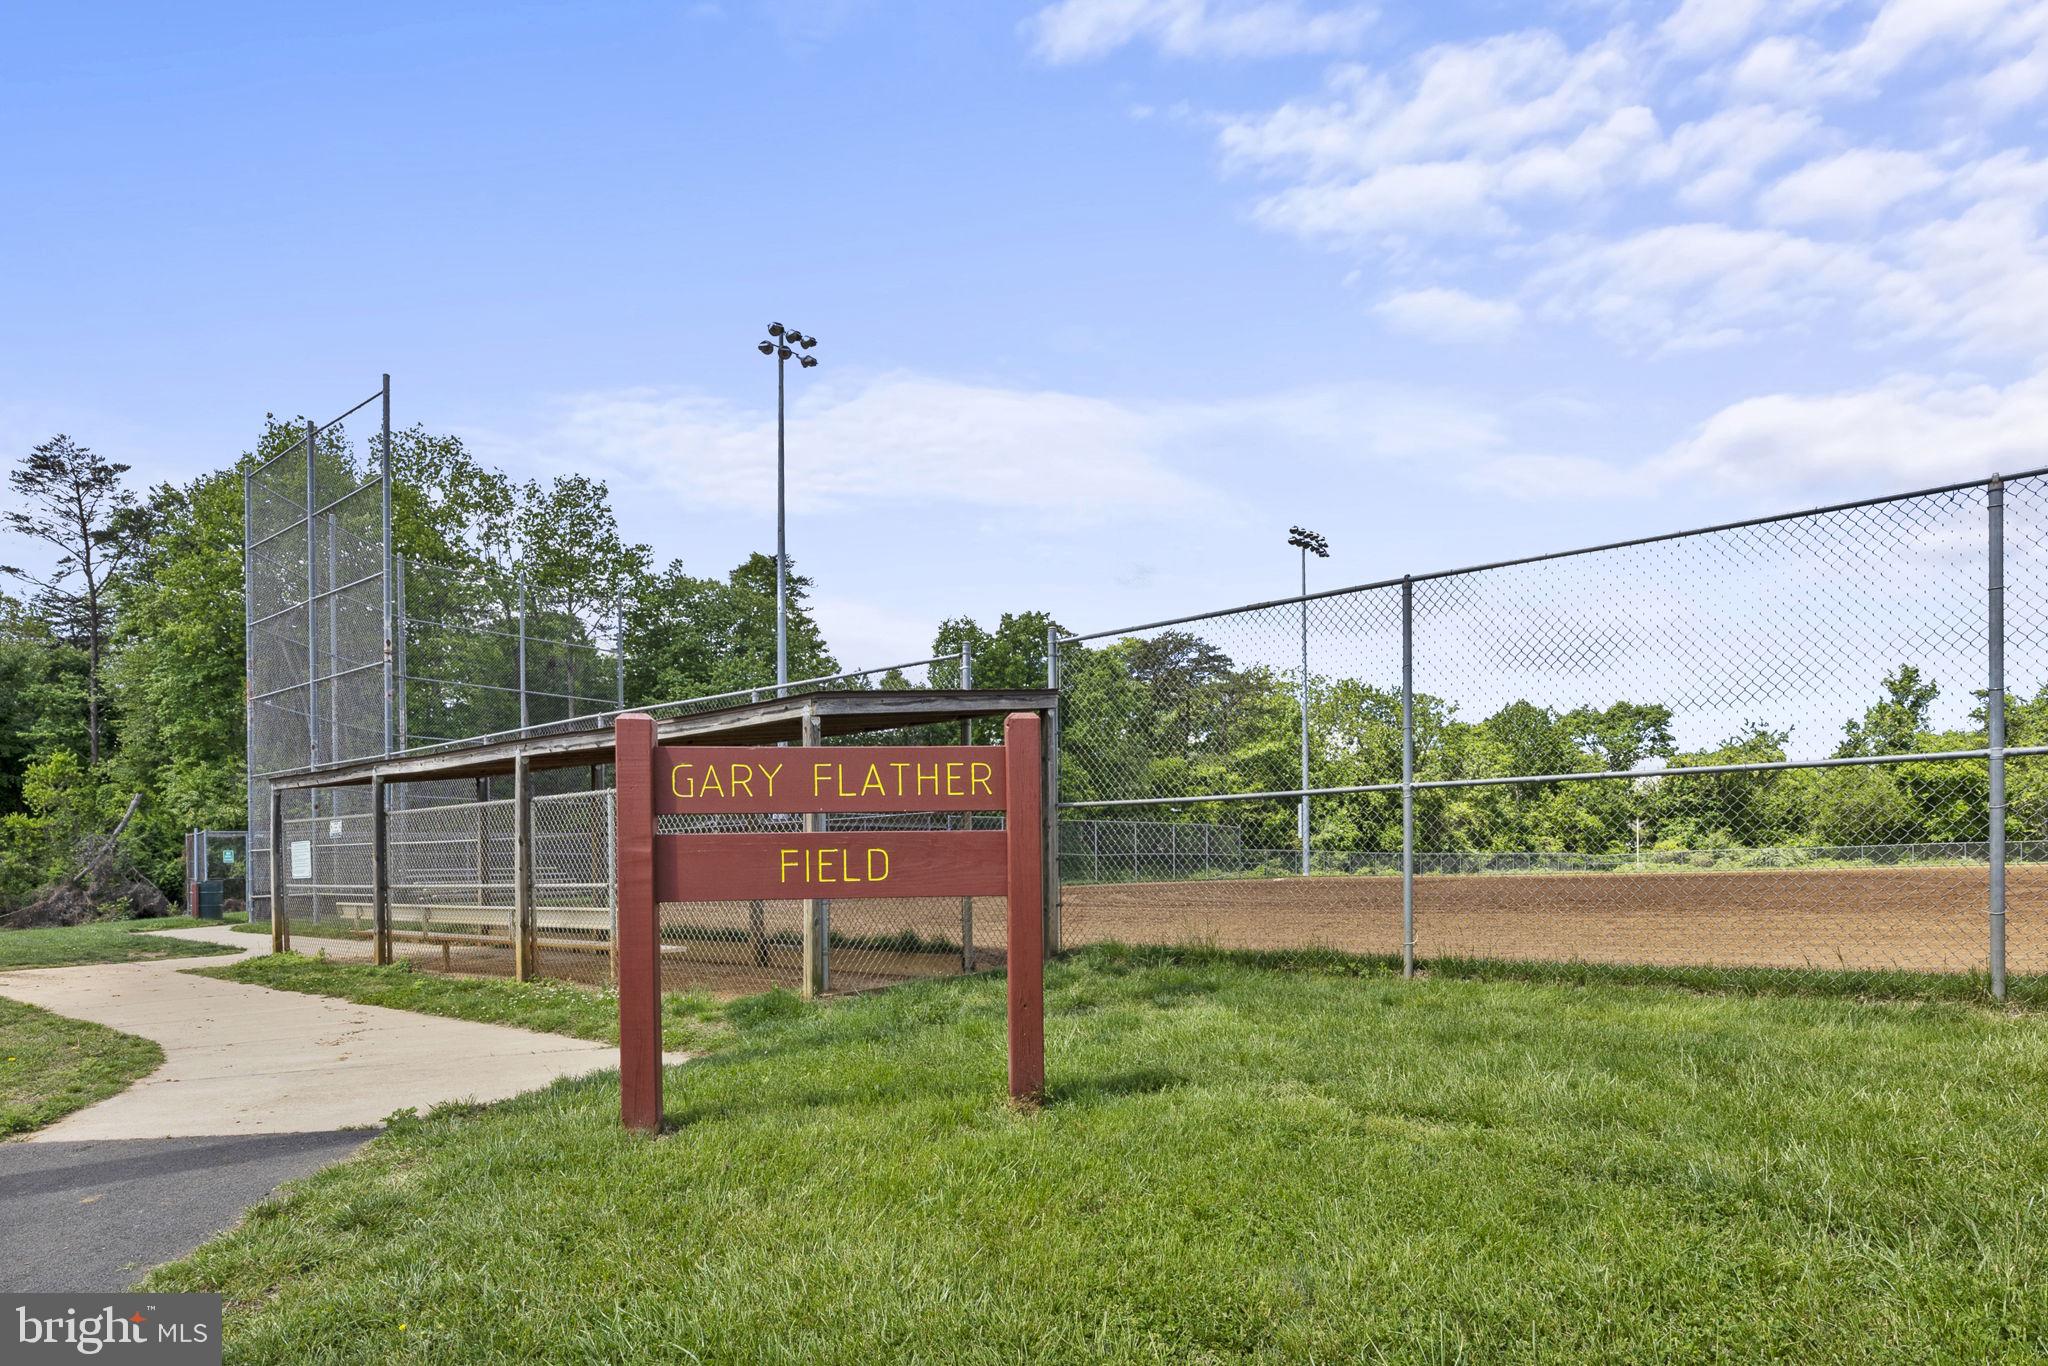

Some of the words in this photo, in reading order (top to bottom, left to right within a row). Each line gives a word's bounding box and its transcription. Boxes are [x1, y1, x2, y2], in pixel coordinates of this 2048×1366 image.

[671, 763, 783, 798] GARY
[814, 762, 993, 797] FLATHER
[780, 848, 889, 883] FIELD
